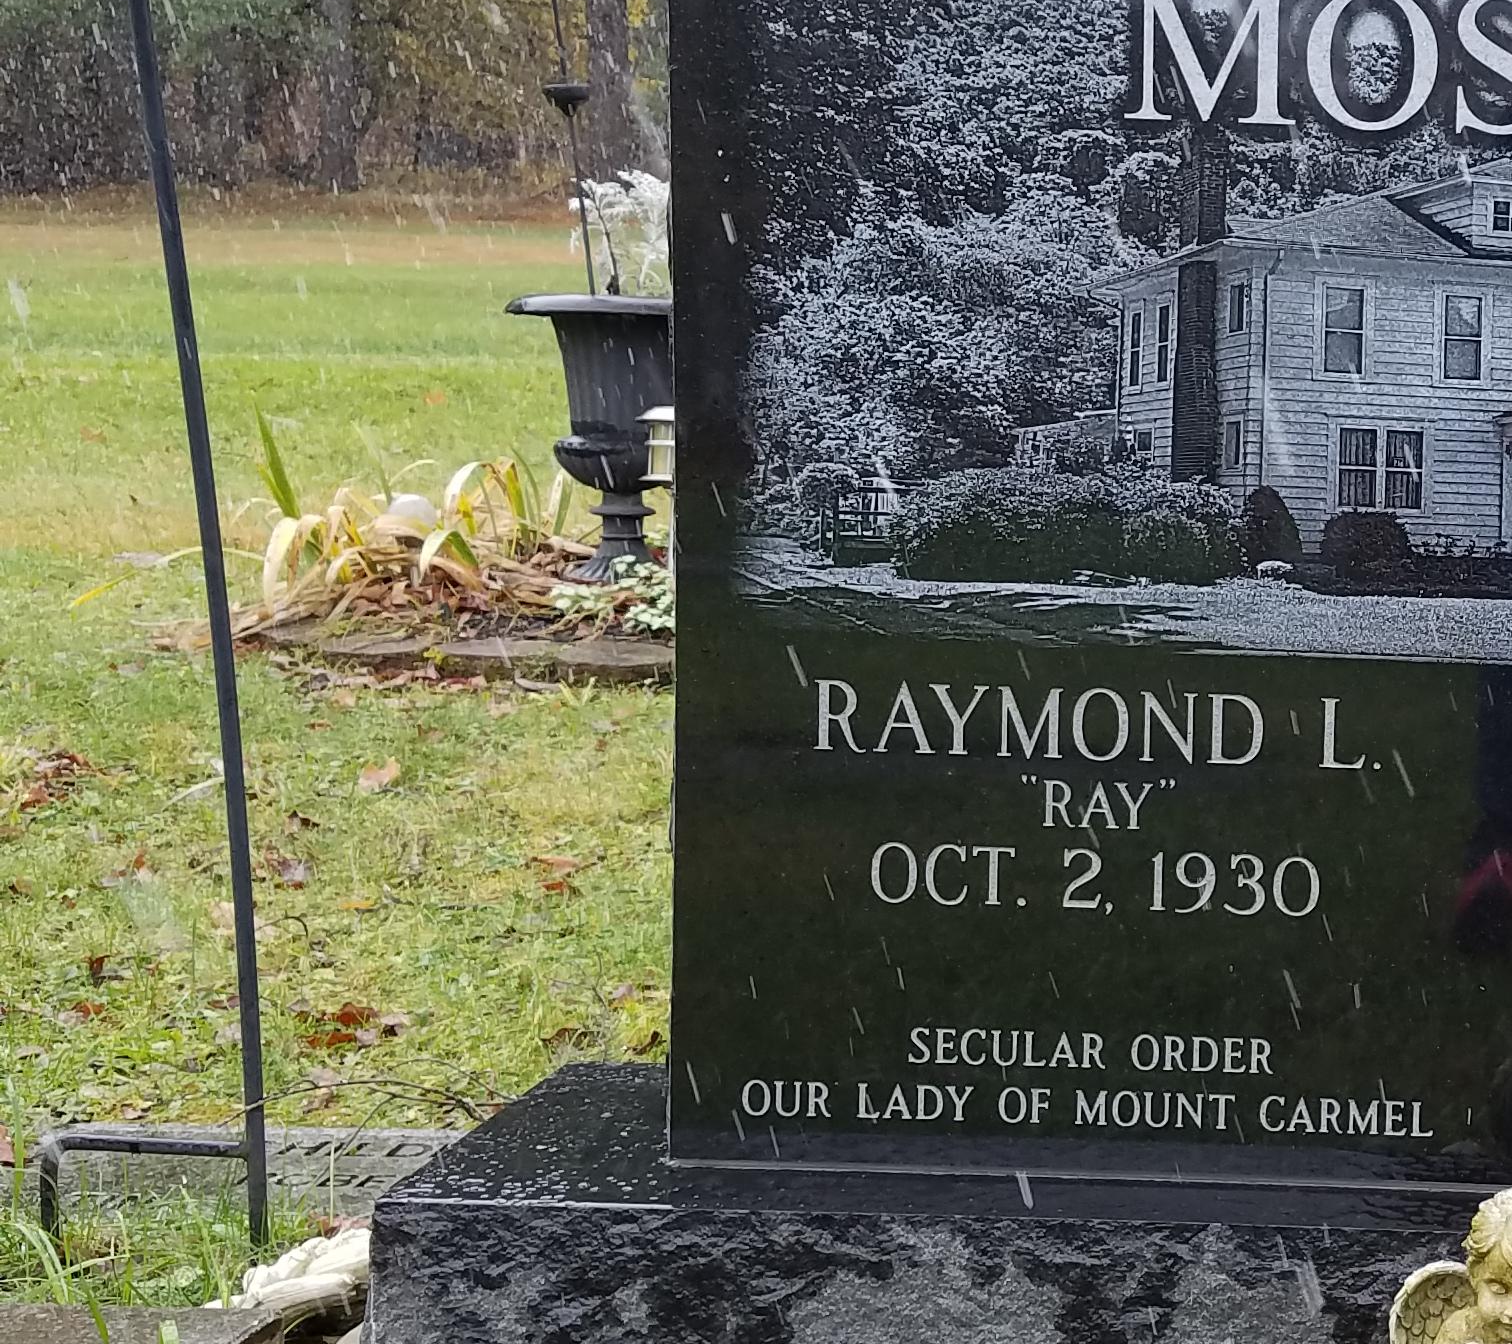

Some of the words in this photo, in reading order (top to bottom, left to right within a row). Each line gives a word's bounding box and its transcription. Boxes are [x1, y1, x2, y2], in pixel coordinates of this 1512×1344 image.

[812, 678, 1264, 766] RAYMOND
[1318, 696, 1384, 771] L.
[871, 842, 1028, 908] OCT.
[1062, 848, 1114, 916] 2,
[1149, 851, 1320, 918] 1930
[908, 1027, 1105, 1071] SECULAR
[1131, 1034, 1275, 1075] ORDER
[742, 1079, 831, 1120] OUR
[856, 1083, 973, 1124] LADY
[998, 1087, 1052, 1126] OF
[1074, 1089, 1237, 1133] MOUNT
[1259, 1097, 1434, 1139] CARMEL
